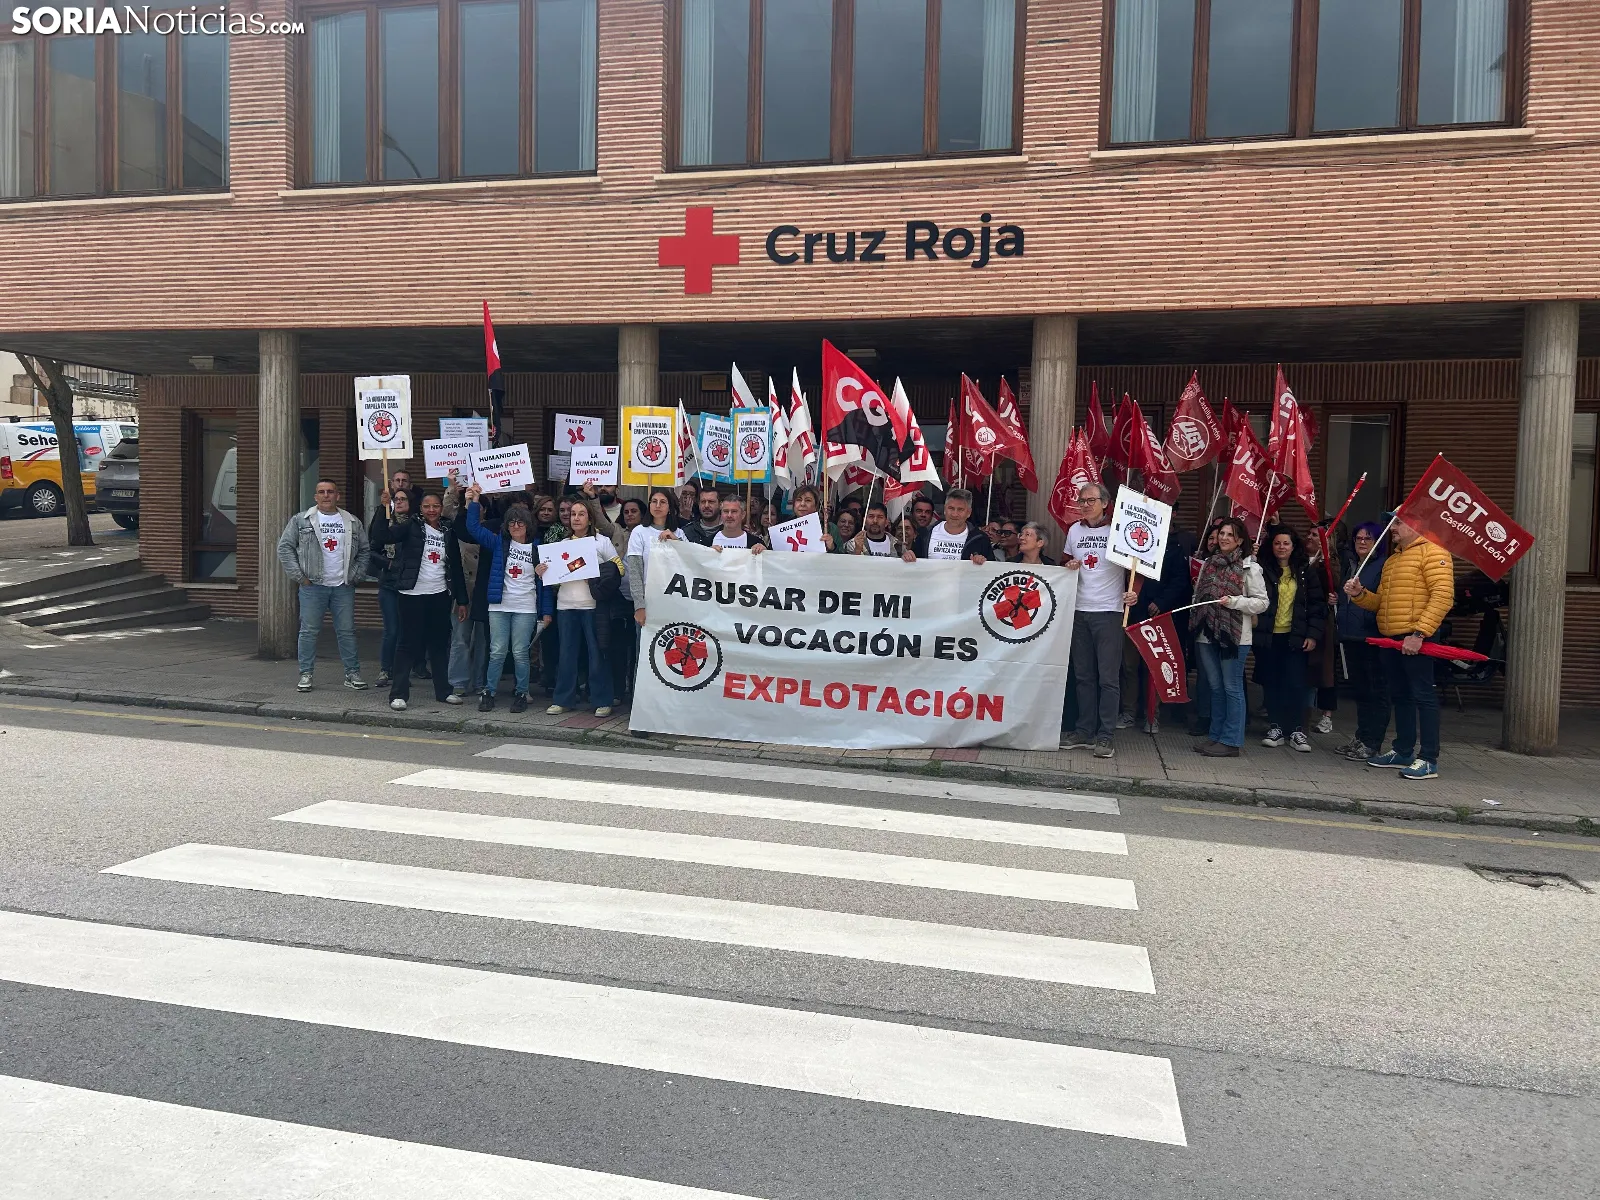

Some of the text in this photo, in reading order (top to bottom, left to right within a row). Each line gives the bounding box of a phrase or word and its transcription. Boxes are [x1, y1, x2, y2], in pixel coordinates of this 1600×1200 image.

[766, 213, 1025, 269] Cruz Roja
[18, 434, 59, 446] Sehe
[477, 463, 504, 472] también
[504, 461, 519, 469] para
[479, 450, 521, 463] HUMANIDAD
[485, 468, 521, 480] PLANTILLA
[576, 468, 600, 476] Empieza
[1428, 476, 1489, 523] UGT
[779, 519, 809, 533] CRUZ ROTA
[1439, 510, 1506, 564] Castilla y León
[664, 573, 912, 619] ABUSAR DE MI
[987, 578, 1012, 603] CRUZ
[657, 627, 681, 648] CRUZ
[734, 623, 979, 662] VOCACIÓN ES
[723, 671, 1005, 723] EXPLOTACIÓN
